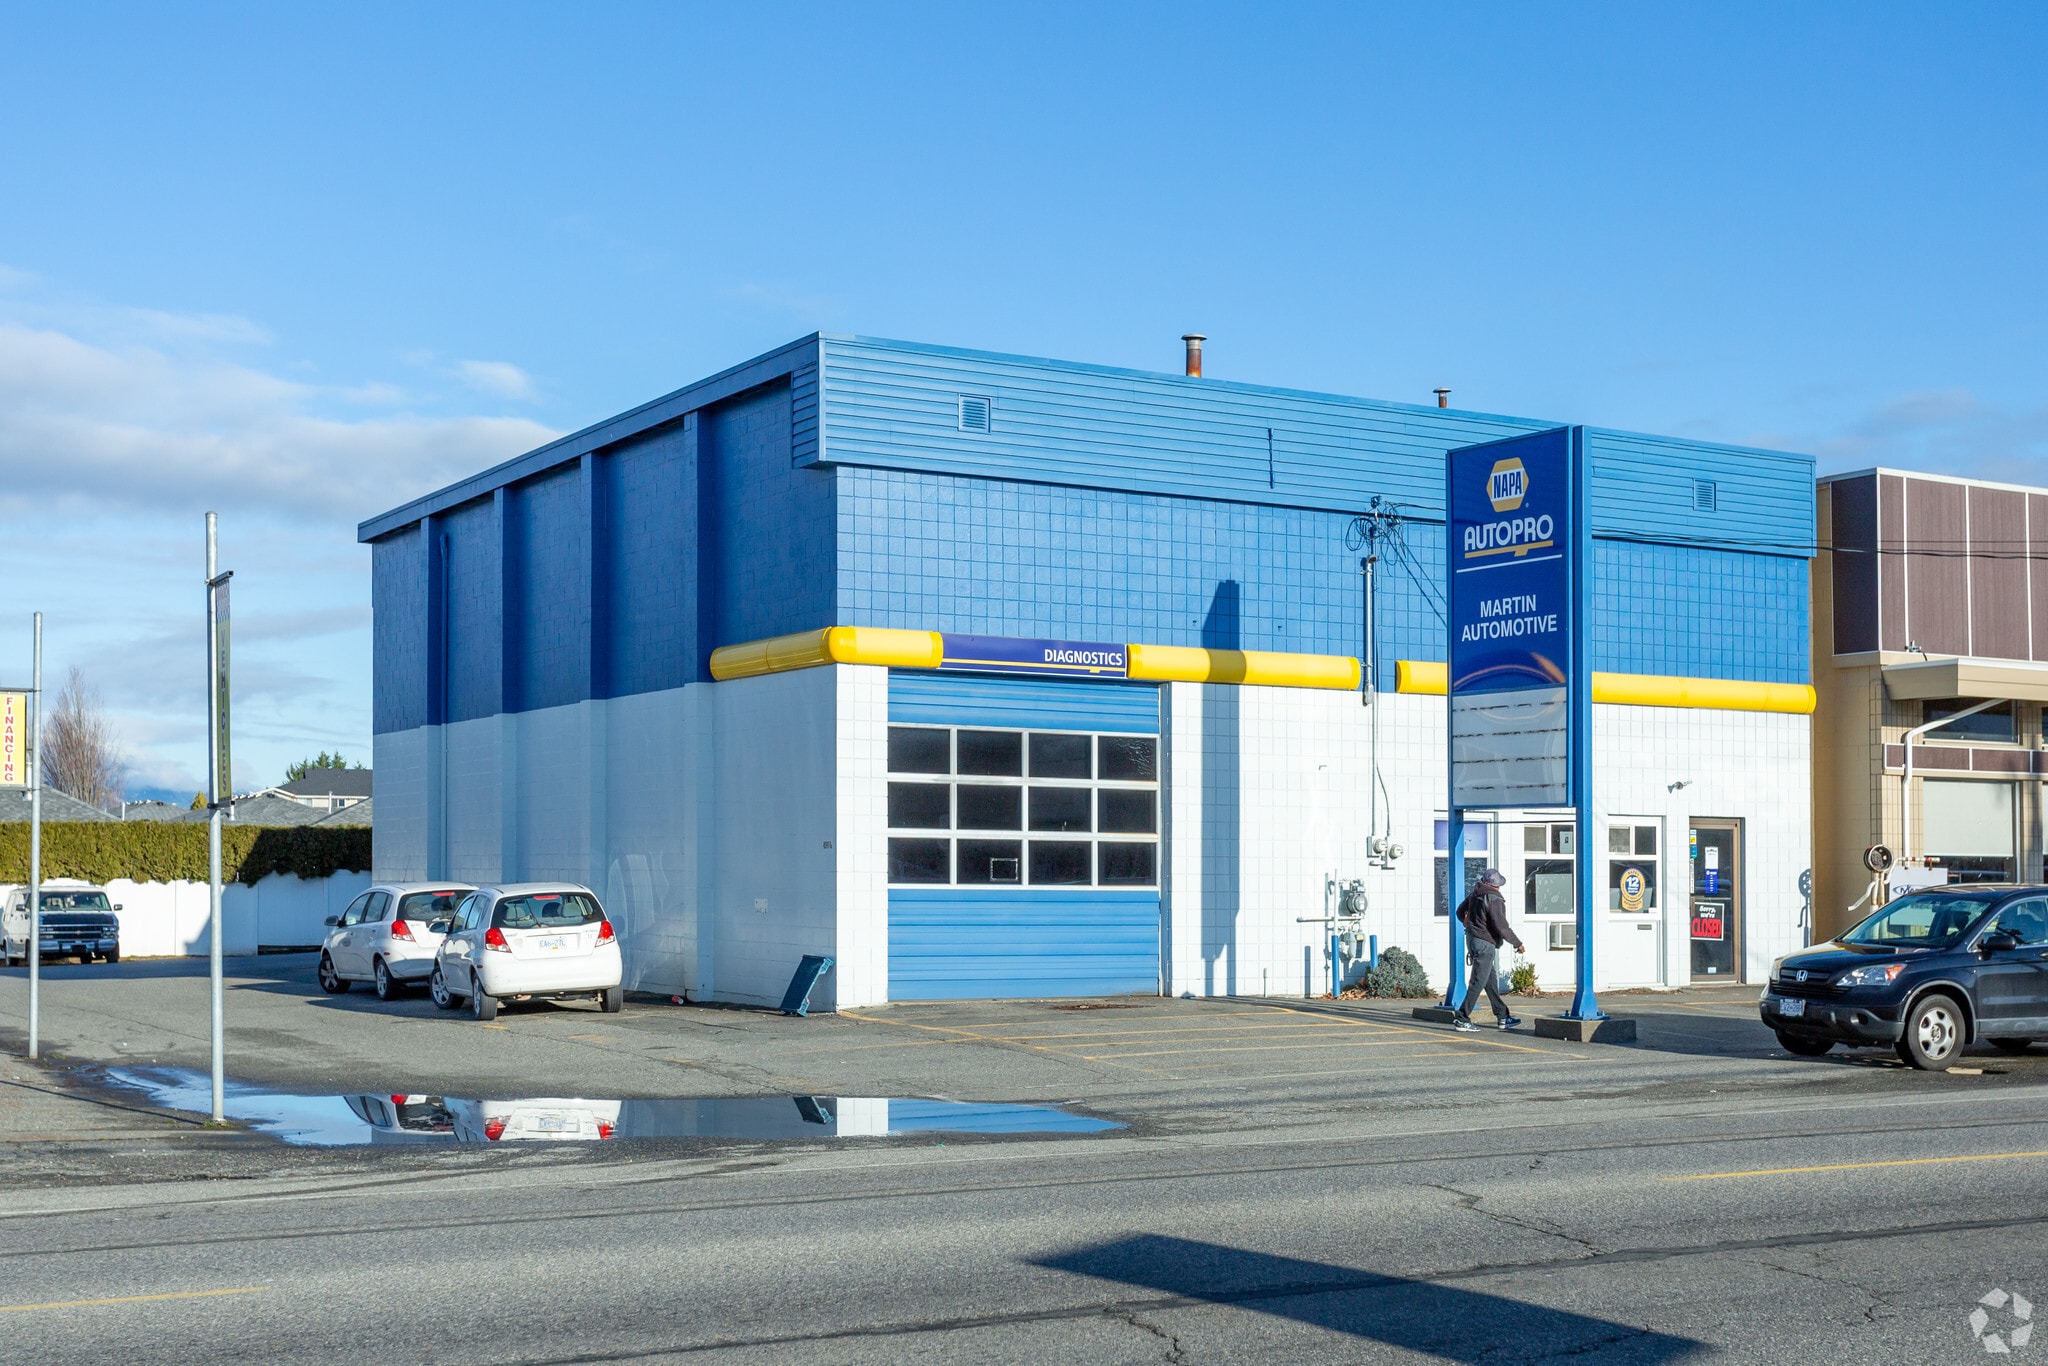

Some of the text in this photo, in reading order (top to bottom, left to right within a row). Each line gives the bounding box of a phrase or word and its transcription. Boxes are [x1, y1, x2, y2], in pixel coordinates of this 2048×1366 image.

[1493, 471, 1522, 499] NAPA
[1464, 514, 1554, 551] AUTOPRO
[1480, 594, 1537, 618] MARTIN
[1461, 614, 1558, 642] AUTOMOTIVE
[1044, 649, 1123, 666] DIAGNOSTICS
[220, 629, 228, 792] VEHICLES
[4, 697, 14, 782] FINANCING
[1626, 876, 1640, 888] 12
[1691, 917, 1722, 938] CLOSED
